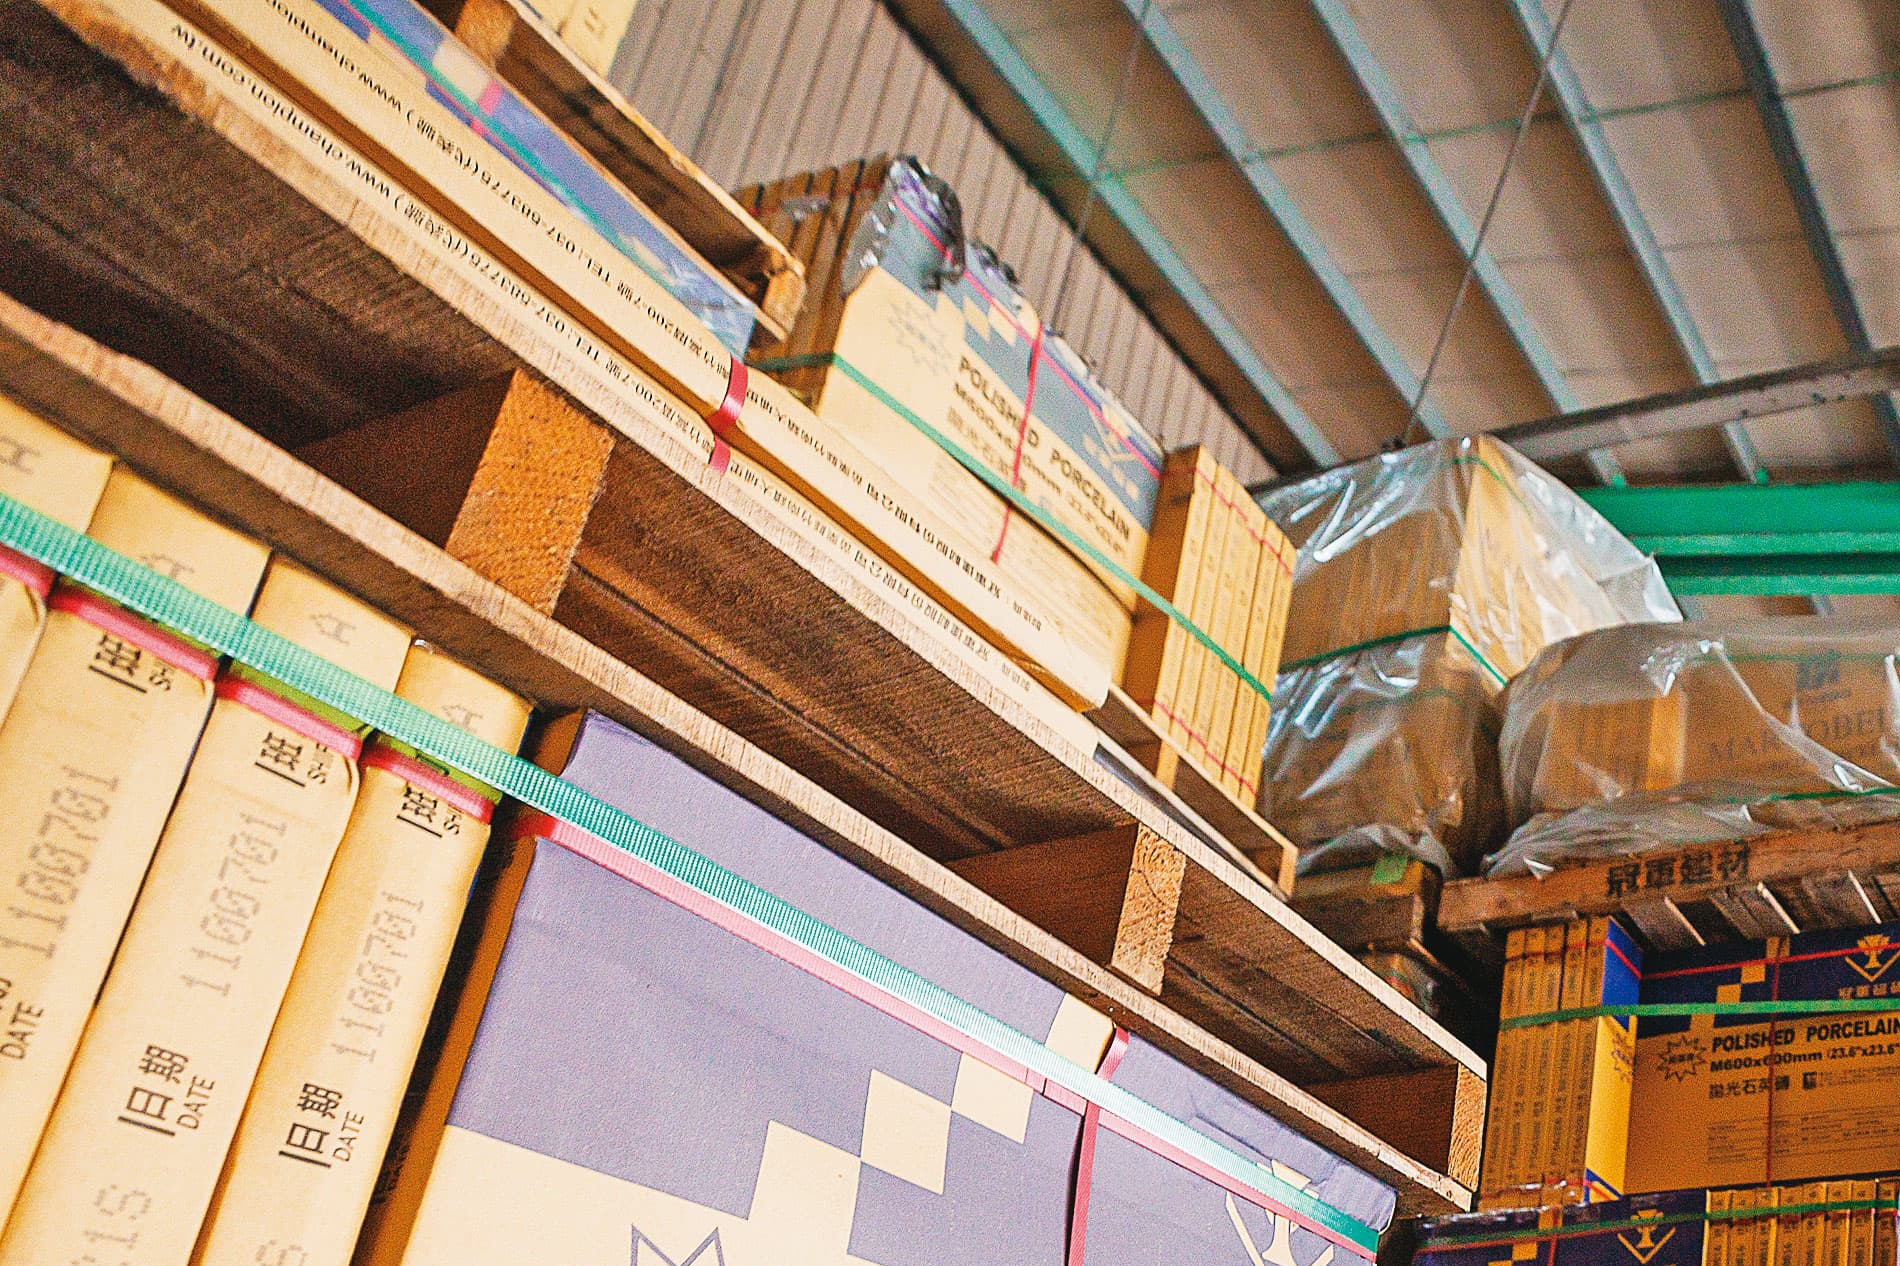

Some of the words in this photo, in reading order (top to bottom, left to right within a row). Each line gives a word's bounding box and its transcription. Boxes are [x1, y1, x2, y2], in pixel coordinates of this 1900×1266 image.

[960, 356, 1040, 448] POLISHD
[1051, 449, 1131, 541] PORCELAIN
[0, 764, 120, 960] 1100701
[179, 810, 289, 999] 1100701
[330, 889, 425, 1064] 1100701
[0, 1001, 45, 1060] DATE
[1711, 1028, 1796, 1053] POLISHED
[125, 1043, 190, 1121] 日期
[176, 1075, 218, 1131] DATE
[285, 1081, 345, 1155] 日期
[333, 1111, 366, 1163] DATE
